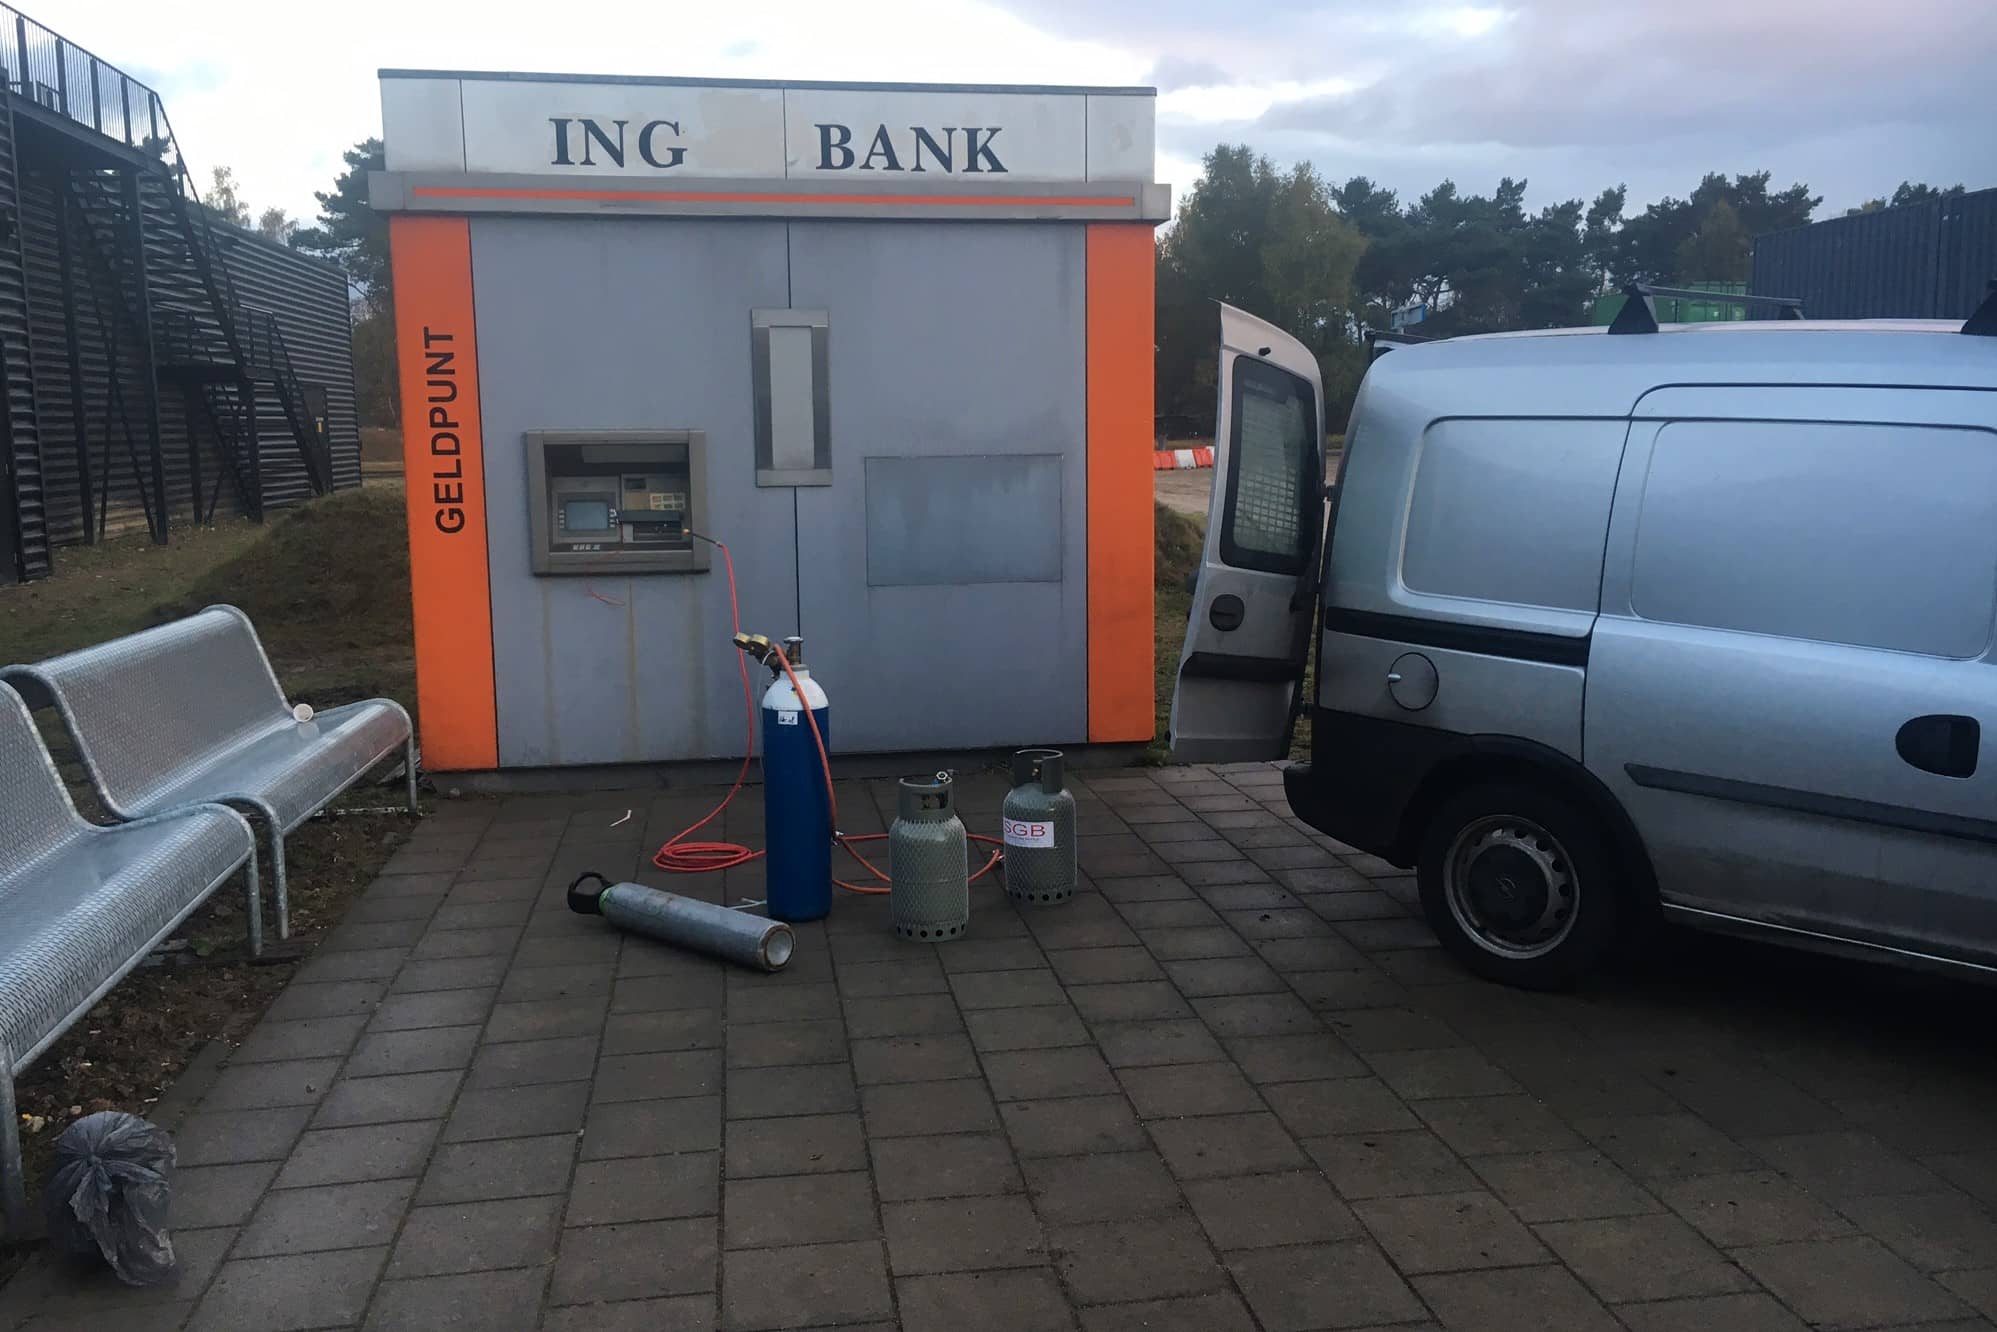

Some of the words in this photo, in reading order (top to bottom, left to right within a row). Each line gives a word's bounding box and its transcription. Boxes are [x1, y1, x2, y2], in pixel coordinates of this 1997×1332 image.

[548, 117, 688, 169] ING
[813, 123, 1009, 173] BANK
[423, 326, 465, 534] GELDPUNT
[1004, 820, 1046, 837] SGB
